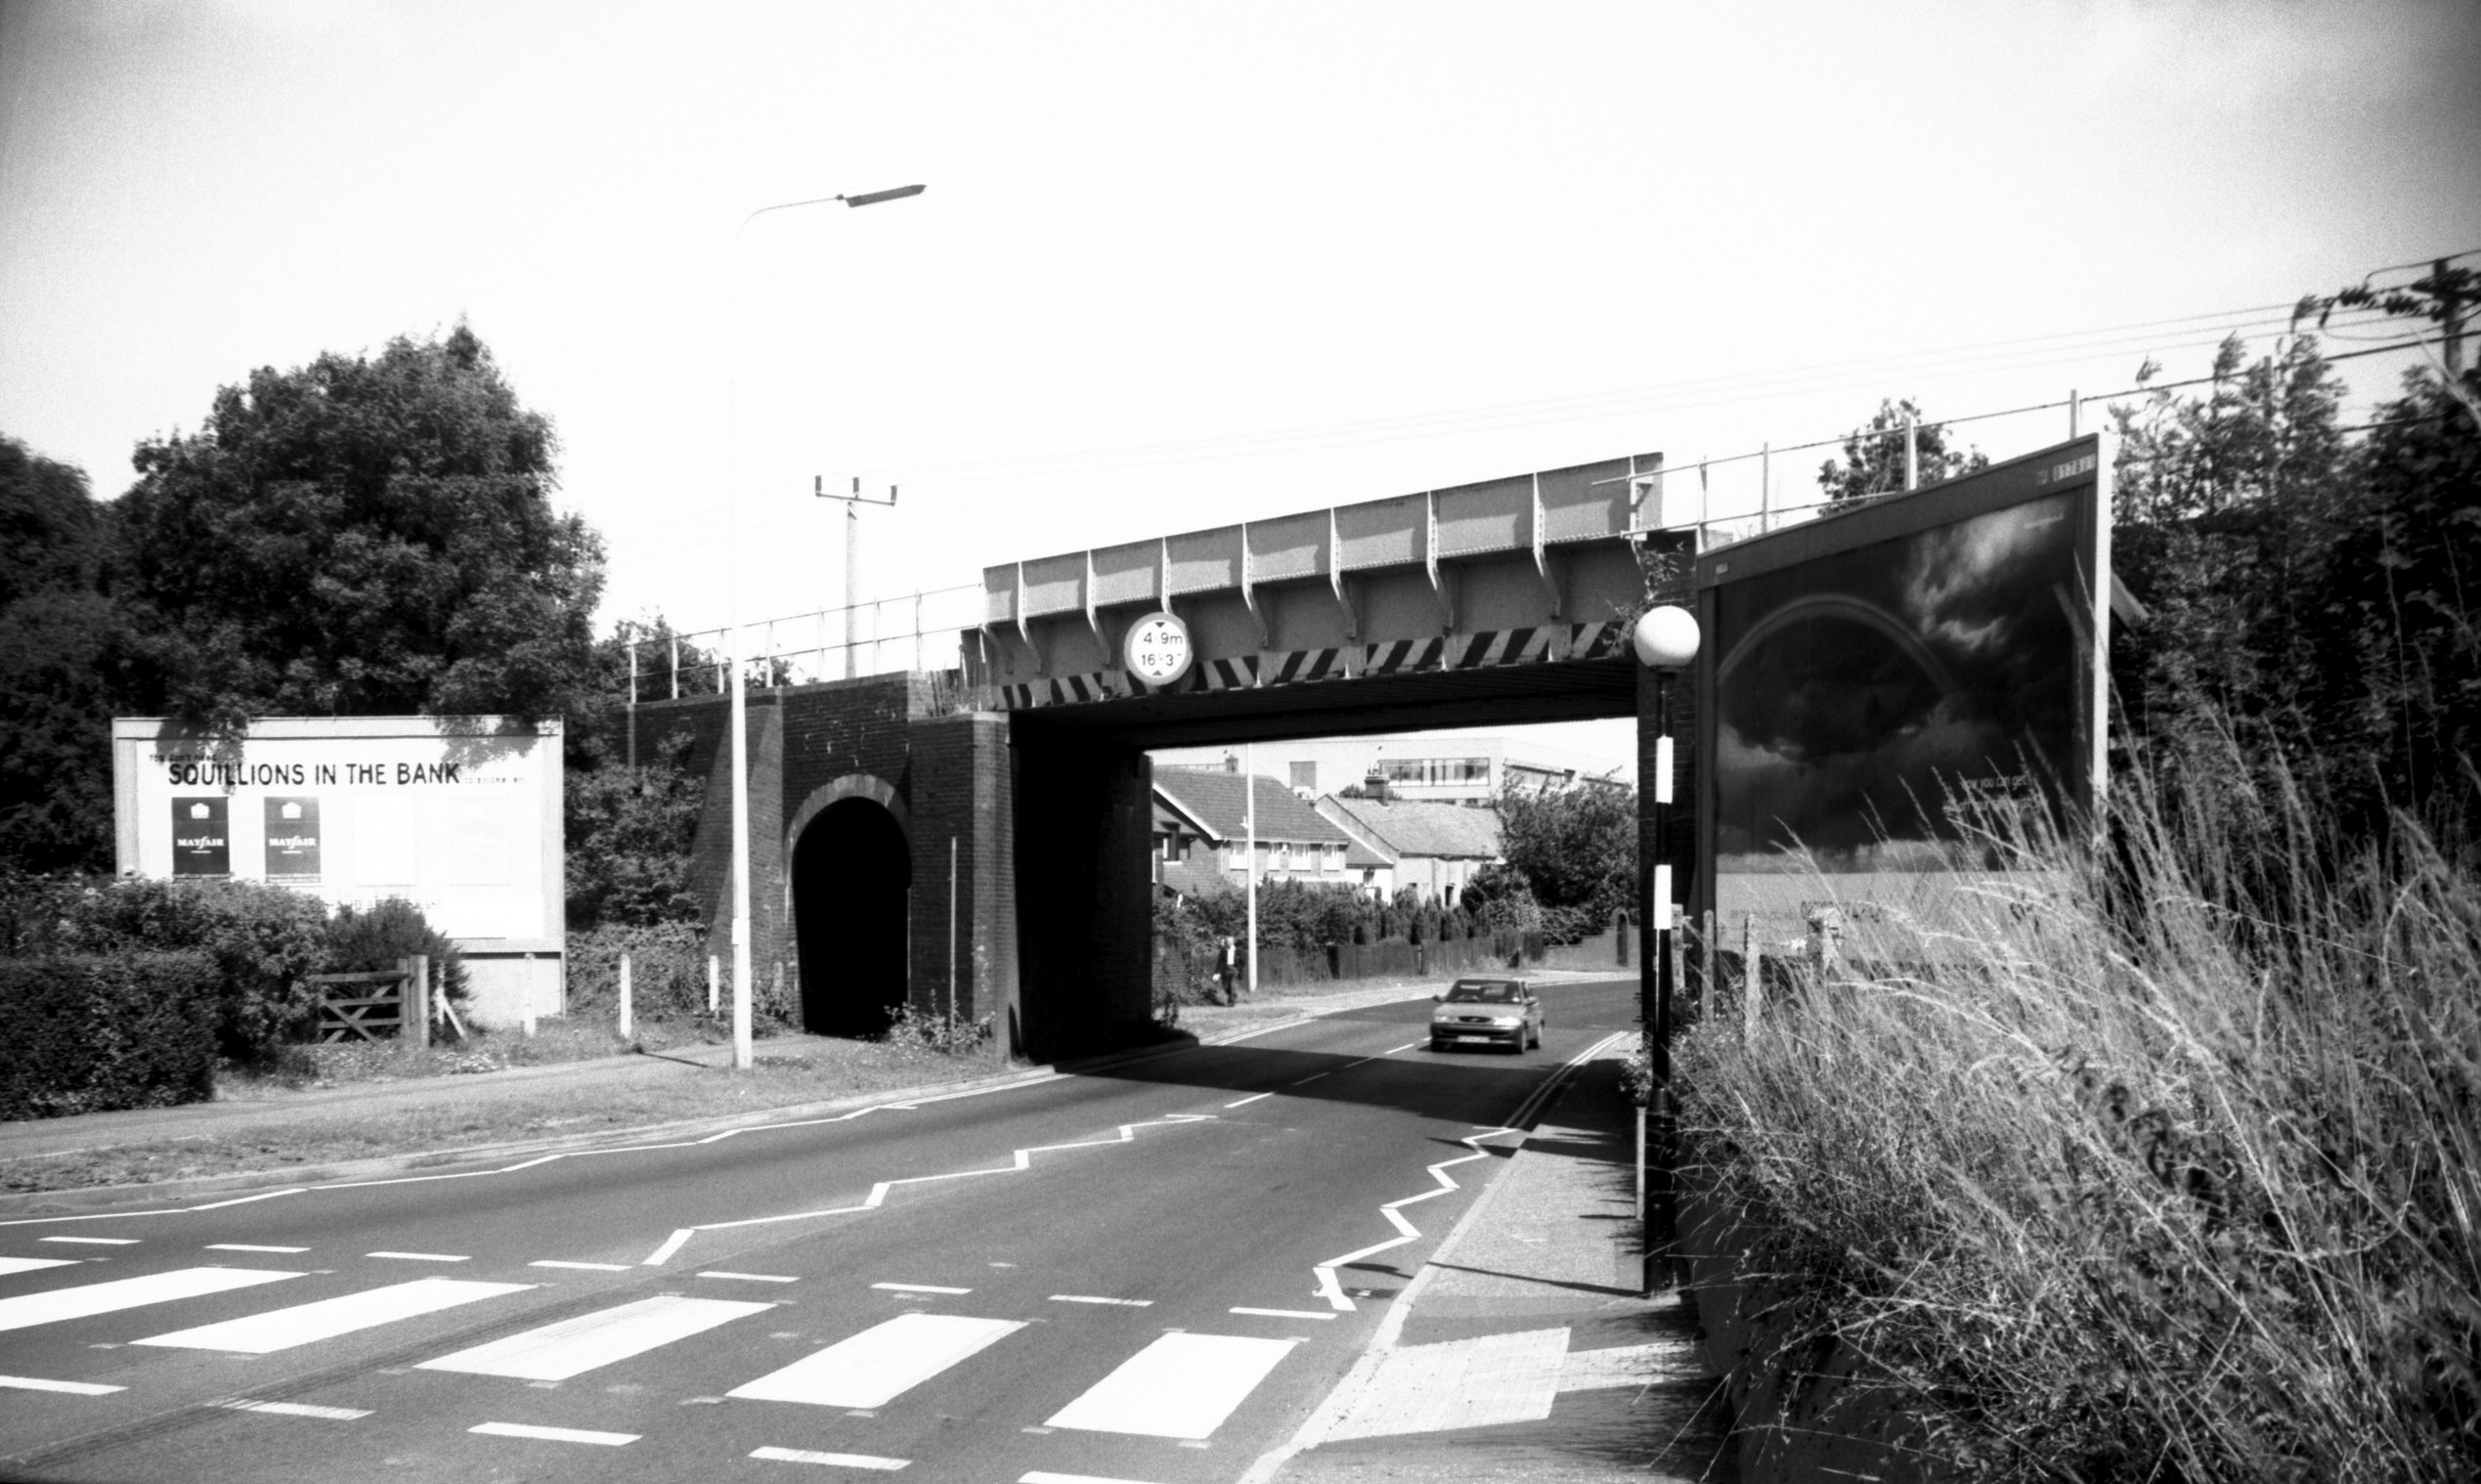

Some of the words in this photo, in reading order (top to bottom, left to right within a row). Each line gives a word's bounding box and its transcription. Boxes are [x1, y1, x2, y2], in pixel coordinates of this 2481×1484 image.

[168, 763, 305, 785] SQUILLIONS
[315, 764, 337, 785] IN
[345, 763, 387, 785] THE
[397, 763, 460, 785] BANK
